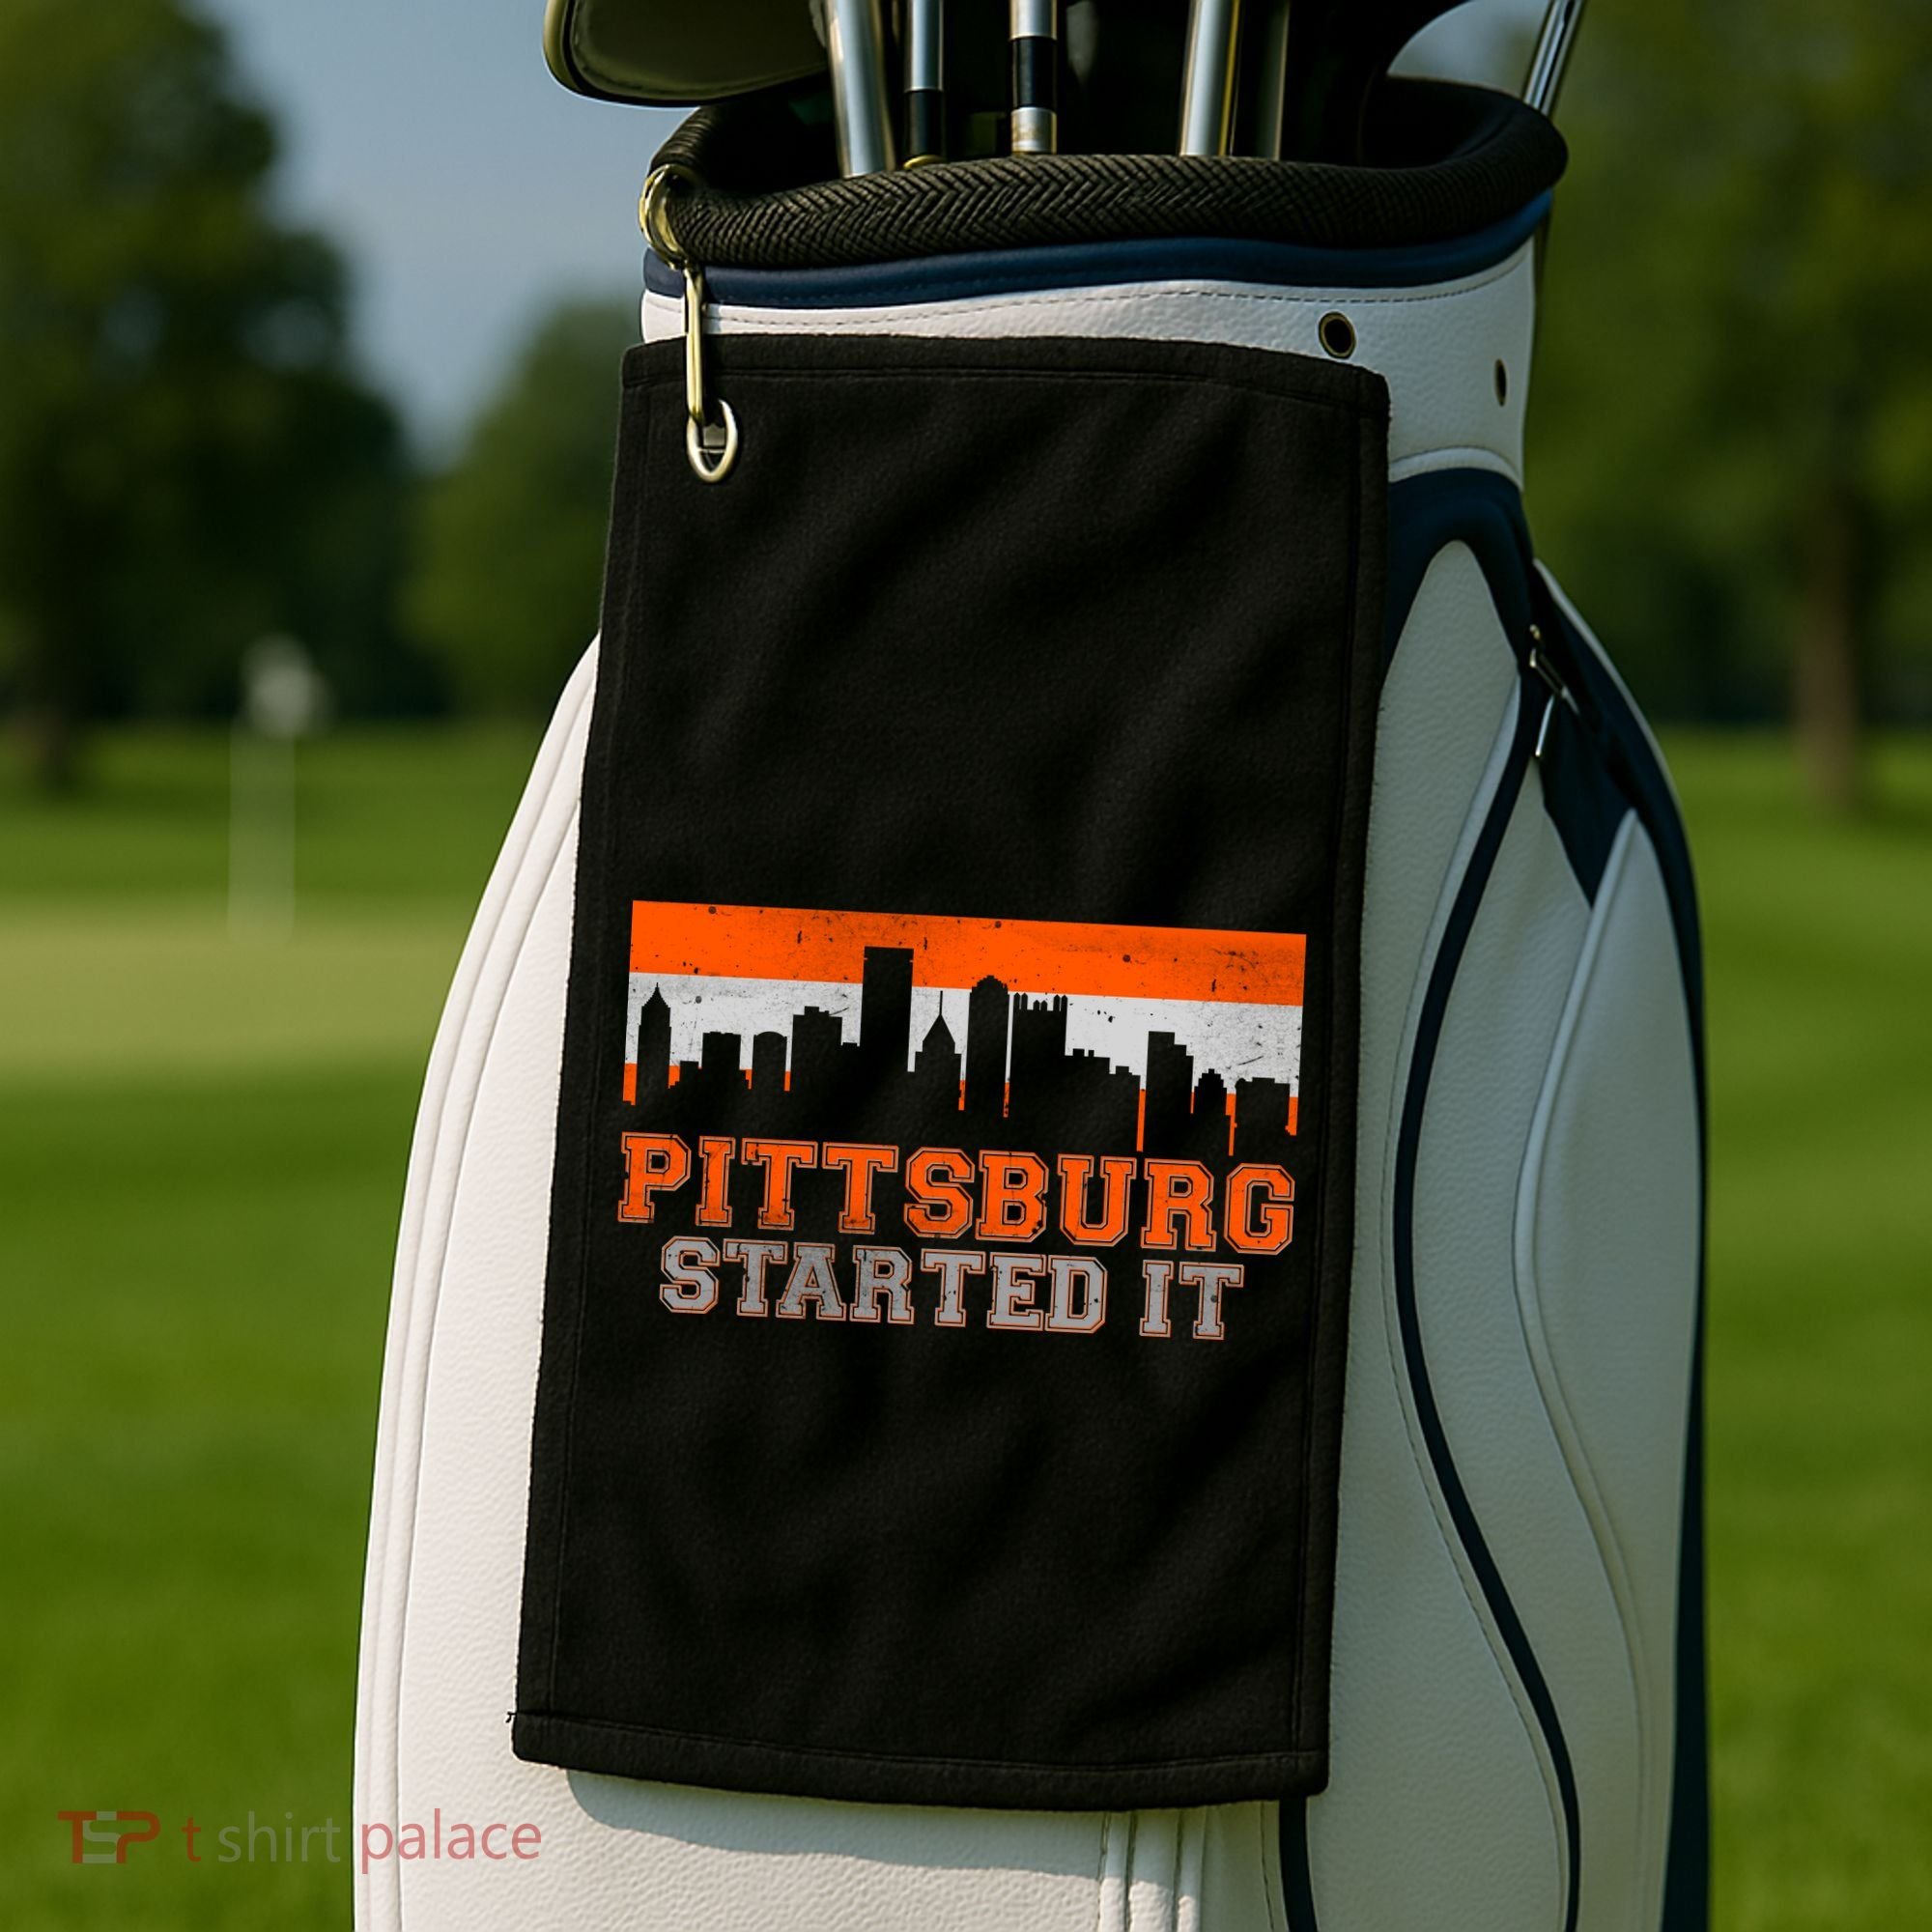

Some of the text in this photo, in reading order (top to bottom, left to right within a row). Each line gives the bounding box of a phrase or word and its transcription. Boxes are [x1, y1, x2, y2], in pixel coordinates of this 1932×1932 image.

[617, 1131, 1295, 1255] PITTSBURG
[660, 1236, 1244, 1340] STARTED IT
